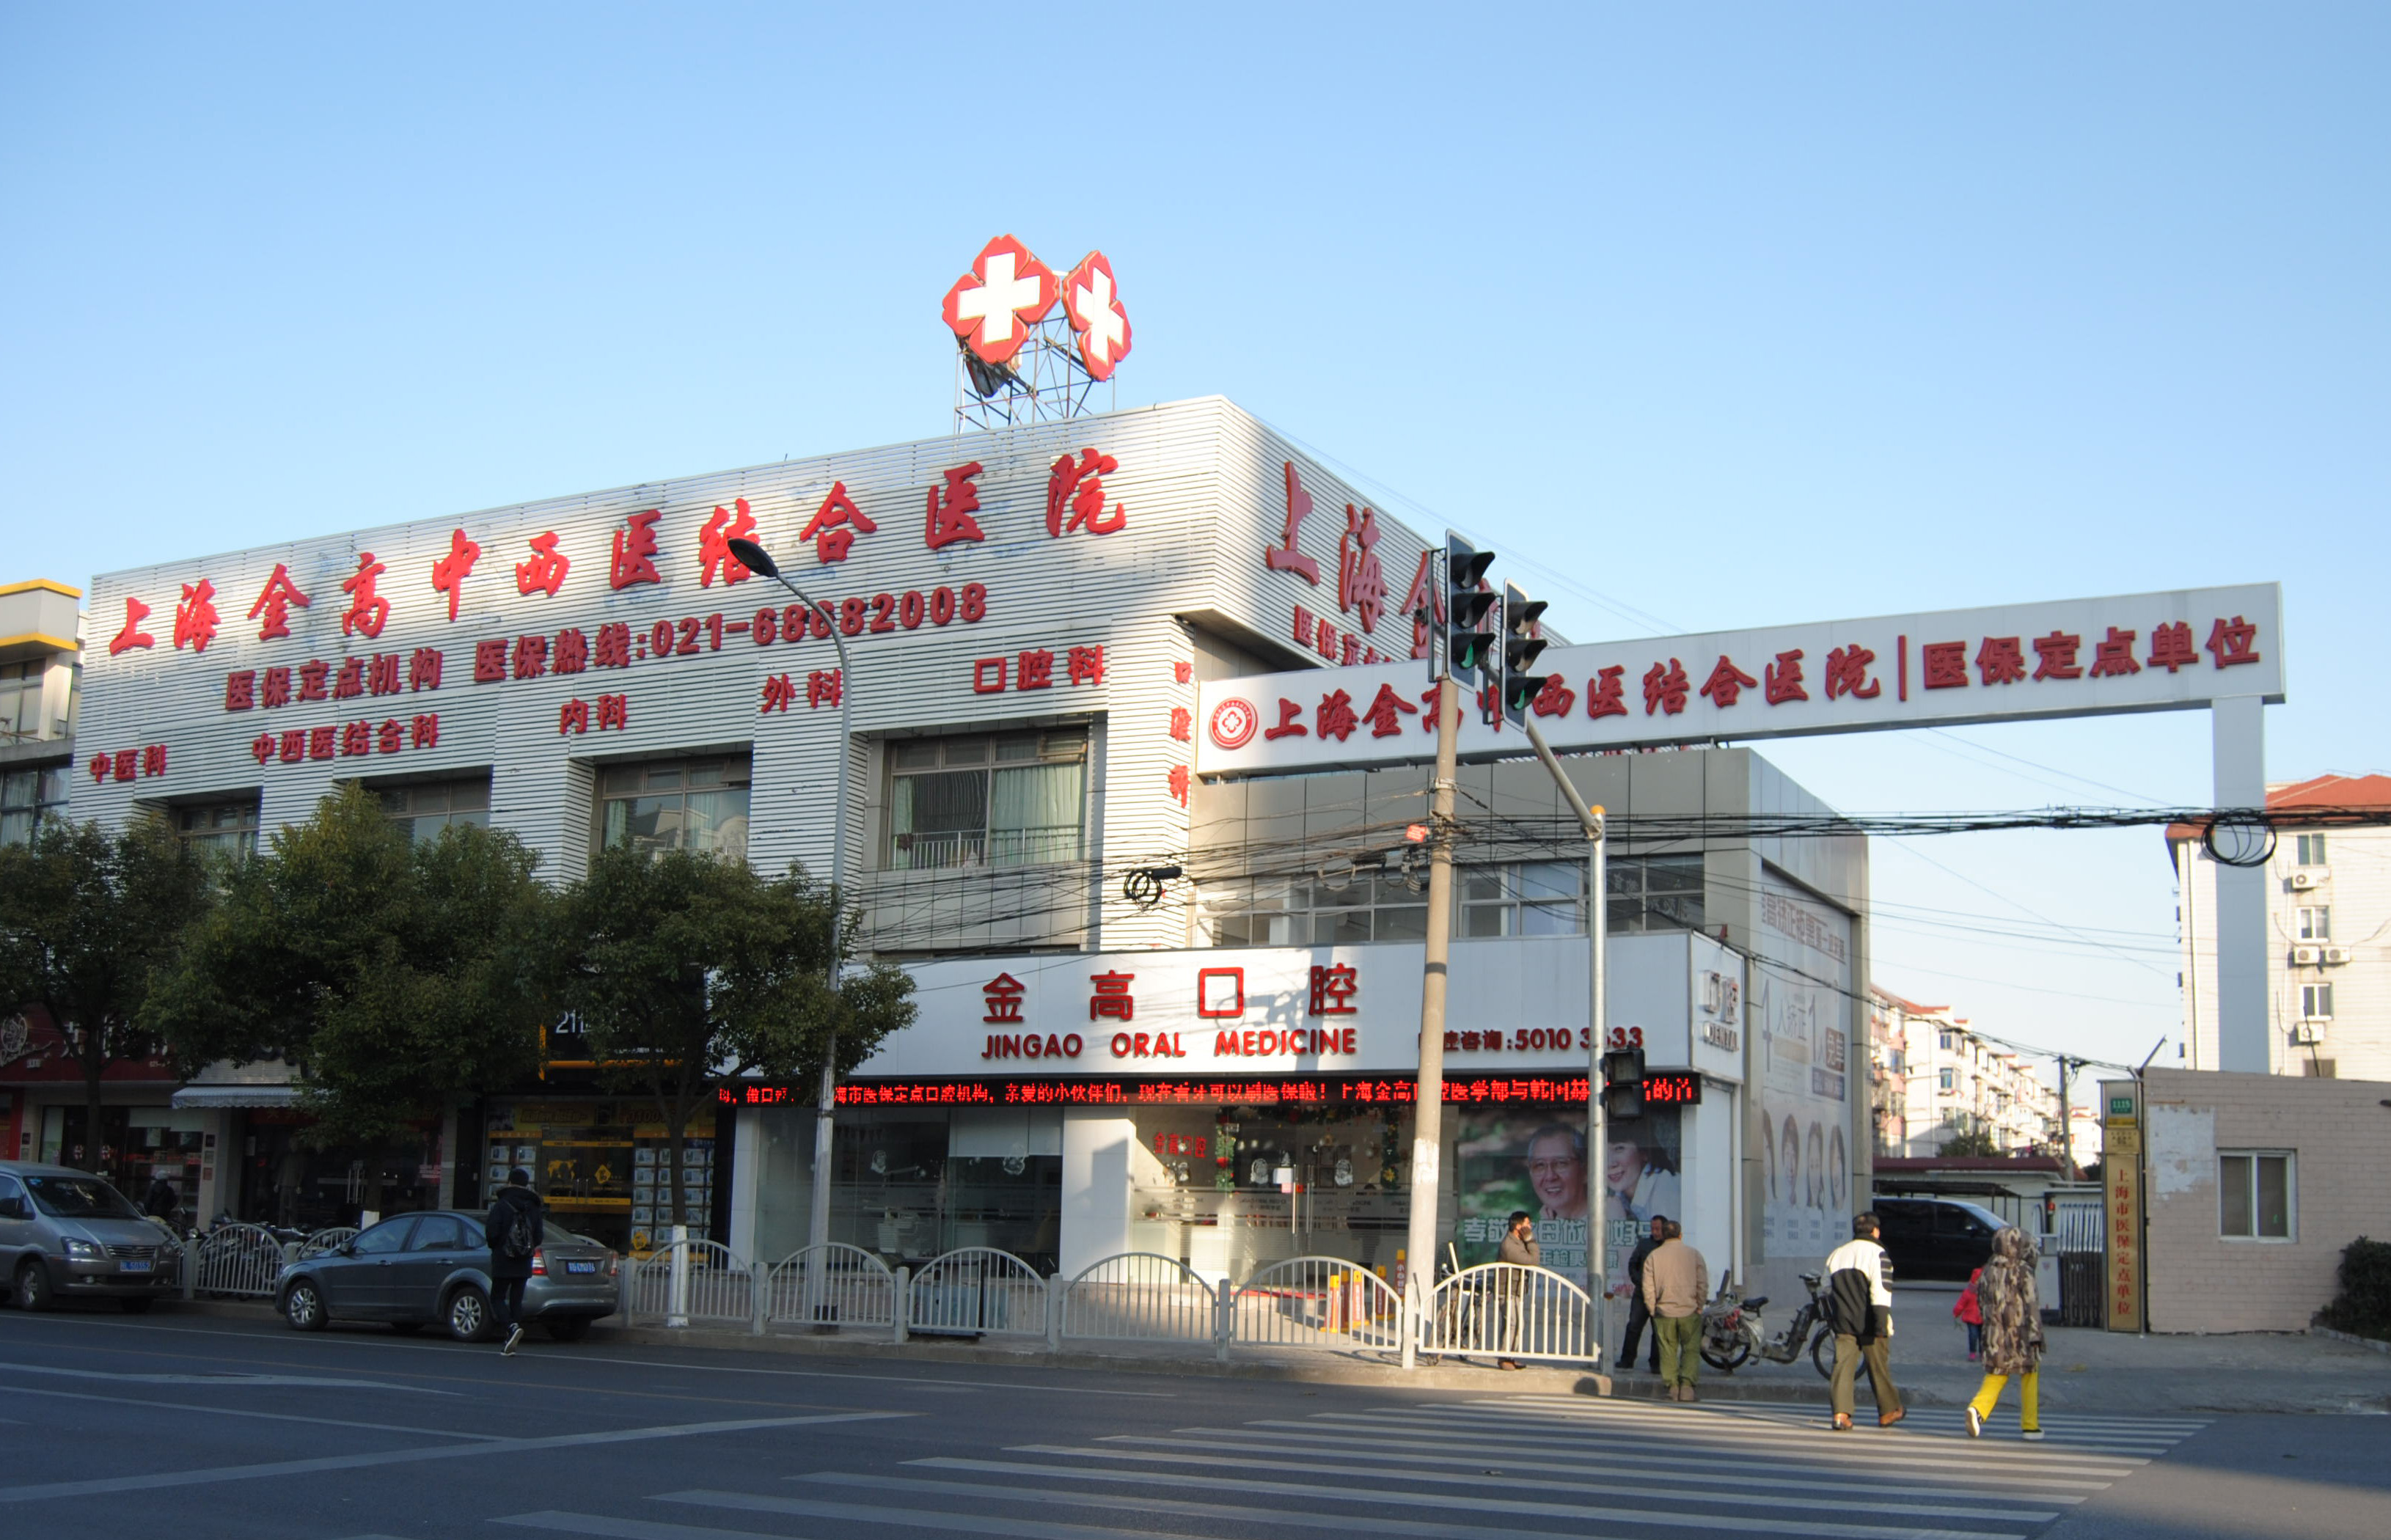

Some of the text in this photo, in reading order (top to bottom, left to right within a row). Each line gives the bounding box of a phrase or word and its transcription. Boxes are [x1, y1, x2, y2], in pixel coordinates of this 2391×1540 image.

[109, 447, 1128, 656] 上海金高中西医结合医院
[1293, 604, 1392, 667] 医保定
[1923, 615, 2260, 689] 医保定点单位
[224, 648, 442, 711] 医保定点机构
[761, 667, 843, 713] 外科
[973, 645, 1107, 693] 口腔科
[252, 713, 439, 764] 中西医结合科
[560, 694, 628, 734] 内科
[89, 744, 167, 782] 中医科
[982, 961, 1358, 1023] 金高口腔
[981, 1027, 1358, 1059] JINGAO ORAL MEDICINE
[1418, 1026, 1644, 1052] 腔咨询:5010 333
[2114, 1169, 2132, 1316] 上海市医保定点单位
